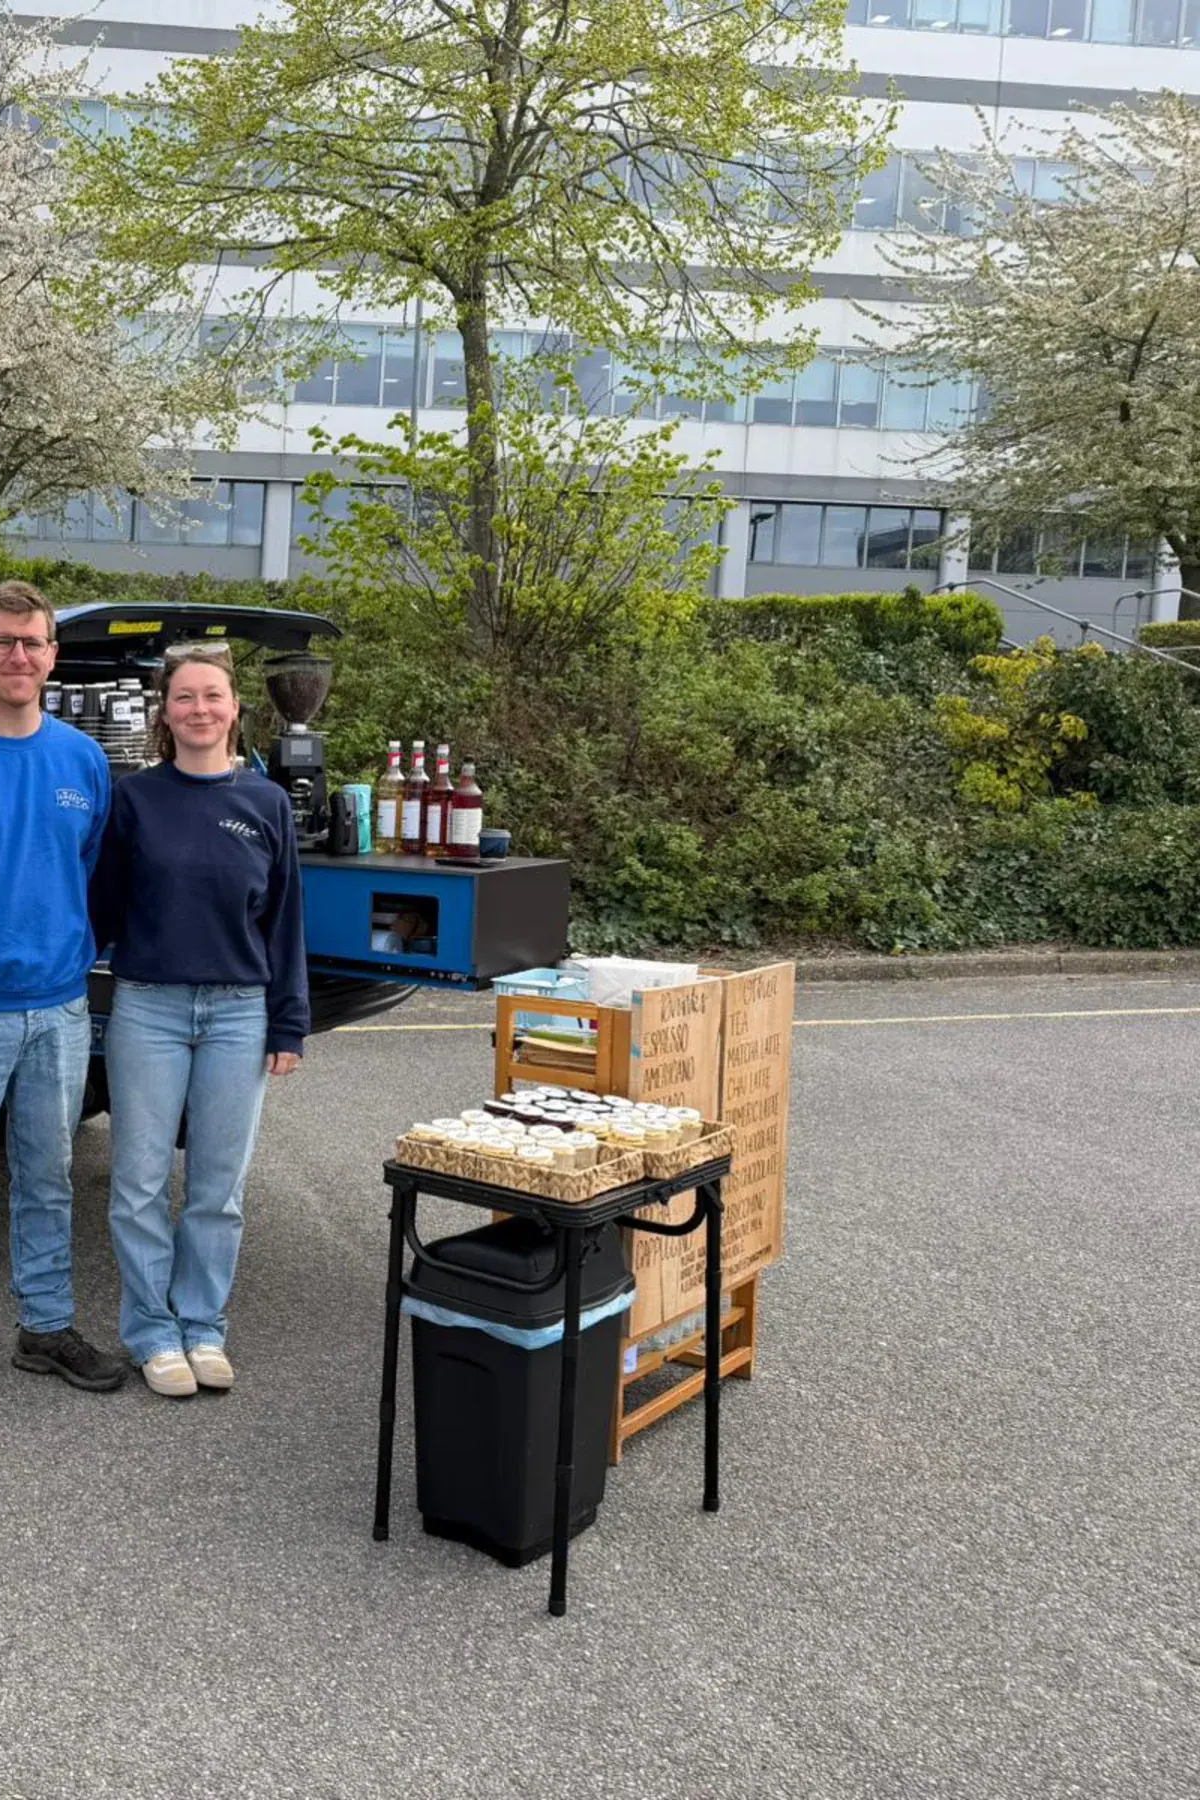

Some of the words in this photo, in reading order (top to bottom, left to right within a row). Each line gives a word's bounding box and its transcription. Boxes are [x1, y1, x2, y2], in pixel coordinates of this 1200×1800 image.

[643, 1022, 690, 1059] ESPRESSO
[730, 1010, 749, 1037] TEA
[727, 1038, 759, 1069] MATCHA
[760, 1032, 781, 1061] LATTE
[642, 1056, 696, 1095] AMERICANO
[749, 1066, 771, 1095] LATTE
